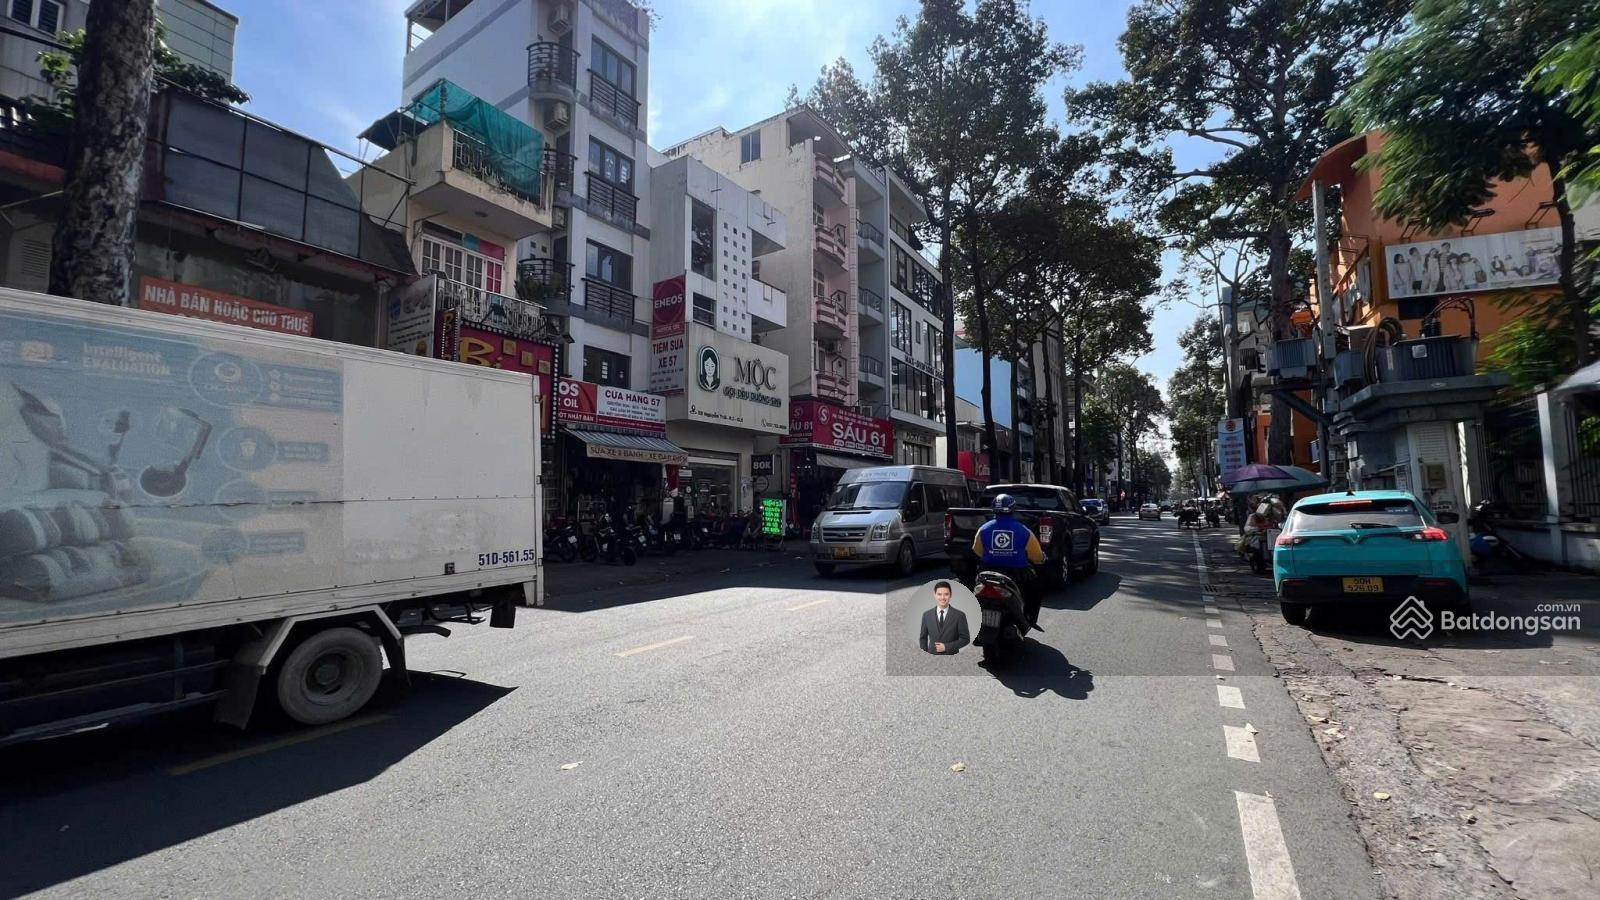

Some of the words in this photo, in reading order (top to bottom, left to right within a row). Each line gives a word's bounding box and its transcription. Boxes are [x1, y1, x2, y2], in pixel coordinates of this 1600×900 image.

[144, 285, 176, 305] NHÀ
[180, 292, 210, 313] BÁN
[654, 294, 683, 309] ENEOS
[658, 356, 668, 368] XE
[668, 354, 678, 367] 57
[734, 356, 776, 391] MỘC
[559, 381, 579, 397] OS
[563, 398, 579, 409] OIL
[650, 397, 661, 407] 57
[832, 422, 867, 444] SÁU
[870, 431, 886, 447] 61
[478, 549, 535, 566] 51D-561.55
